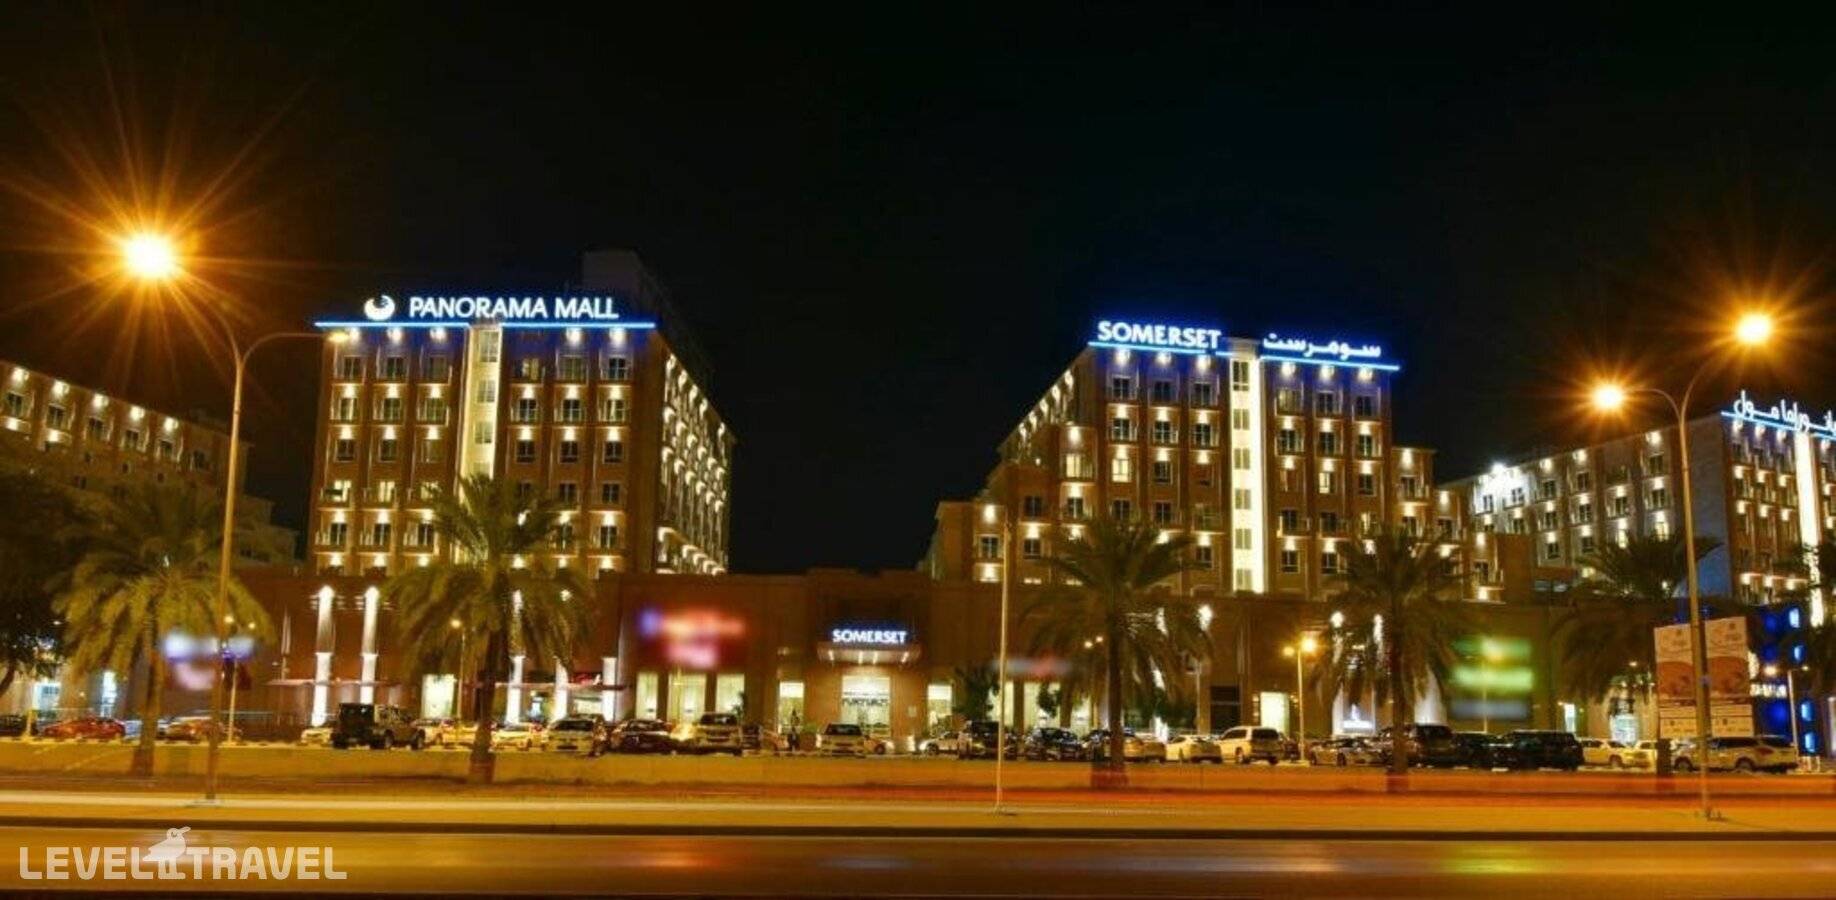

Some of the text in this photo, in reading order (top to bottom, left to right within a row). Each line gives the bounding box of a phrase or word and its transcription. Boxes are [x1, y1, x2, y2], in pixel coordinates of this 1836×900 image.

[409, 297, 620, 319] PANORAMA MALL
[1097, 320, 1222, 350] SOMERSET
[1263, 331, 1382, 360] سومرست
[832, 628, 908, 644] SOMERSET
